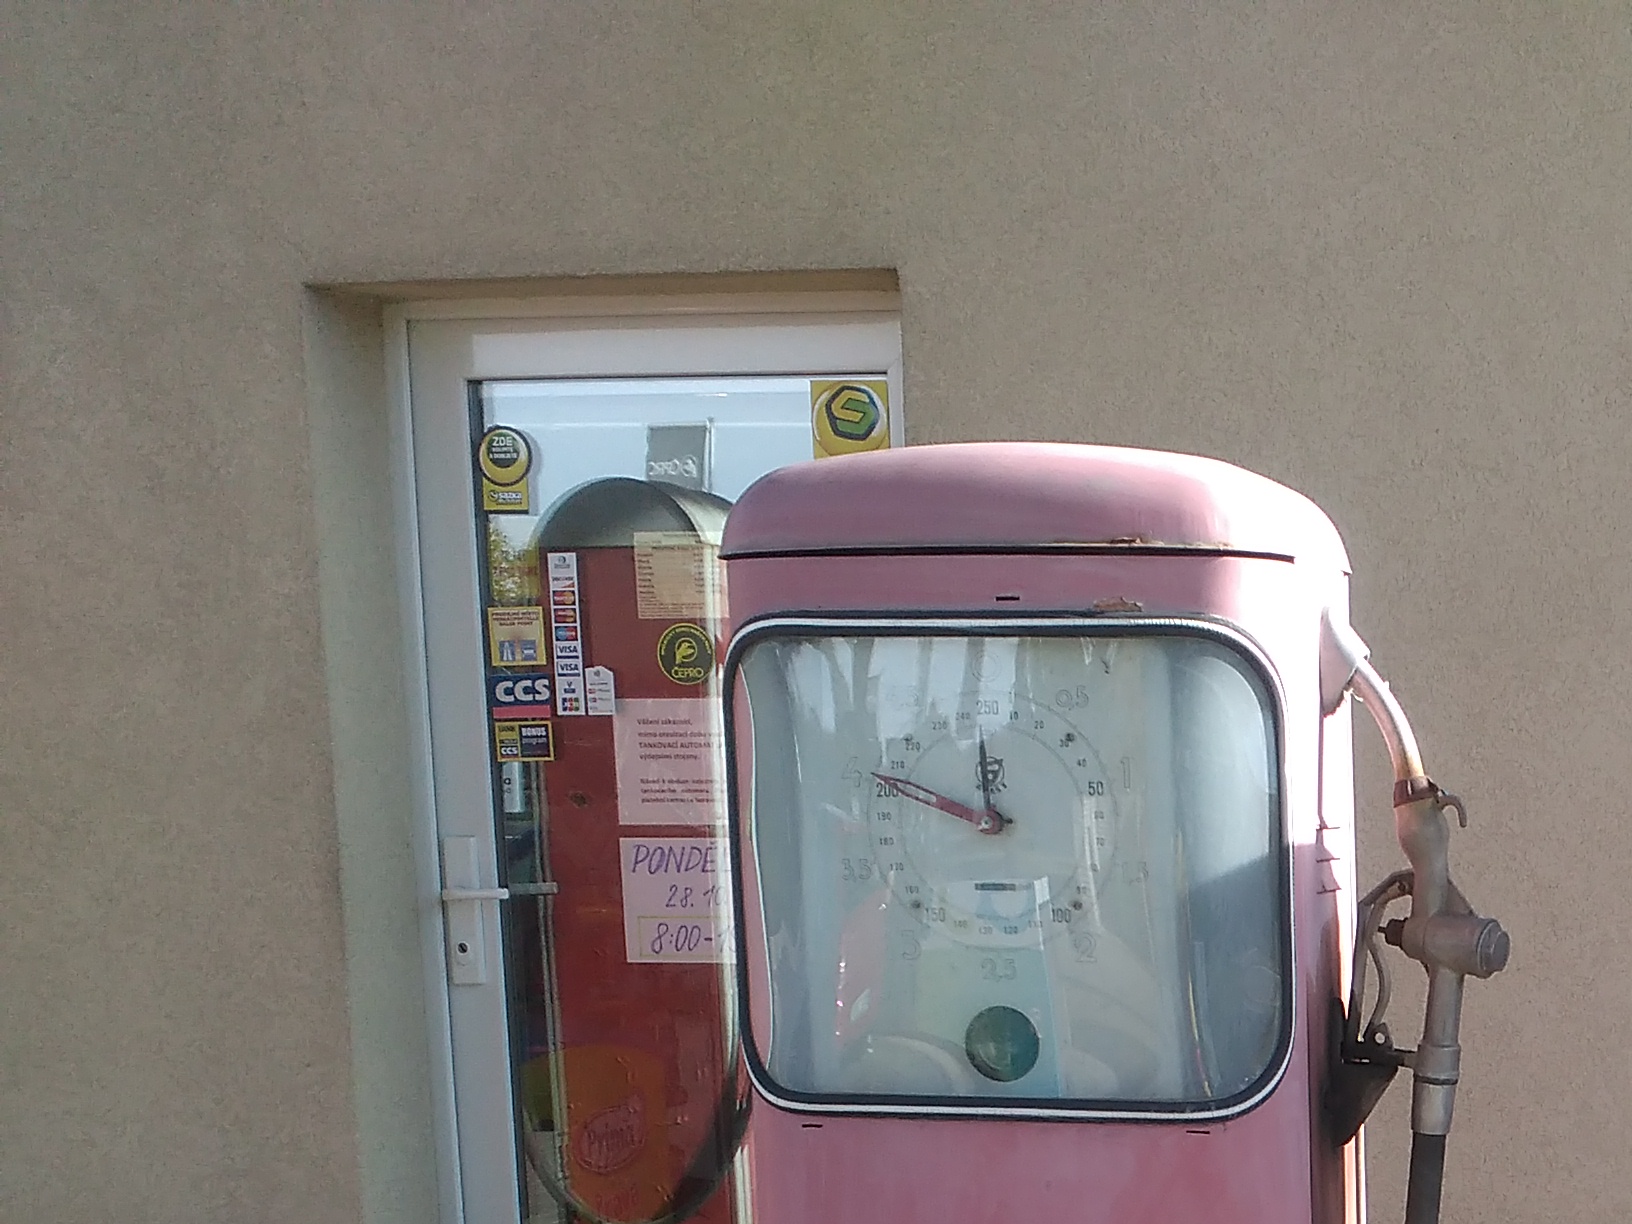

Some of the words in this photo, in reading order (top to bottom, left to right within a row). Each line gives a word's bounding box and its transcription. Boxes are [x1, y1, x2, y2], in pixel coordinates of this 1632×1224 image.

[492, 436, 513, 446] ZDE
[559, 645, 578, 653] VISA
[560, 663, 579, 671] VISA
[672, 666, 704, 678] ČEPRO
[495, 678, 550, 702] CCS
[976, 700, 999, 716] 250
[1034, 721, 1044, 730] 20
[521, 727, 546, 736] BONUS
[501, 746, 518, 755] CCS
[891, 761, 905, 769] 210
[1077, 759, 1087, 767] 40
[876, 782, 899, 798] 200
[1088, 781, 1104, 796] 50
[665, 884, 694, 908] 28.
[925, 907, 946, 923] 150
[1052, 908, 1072, 924] 100
